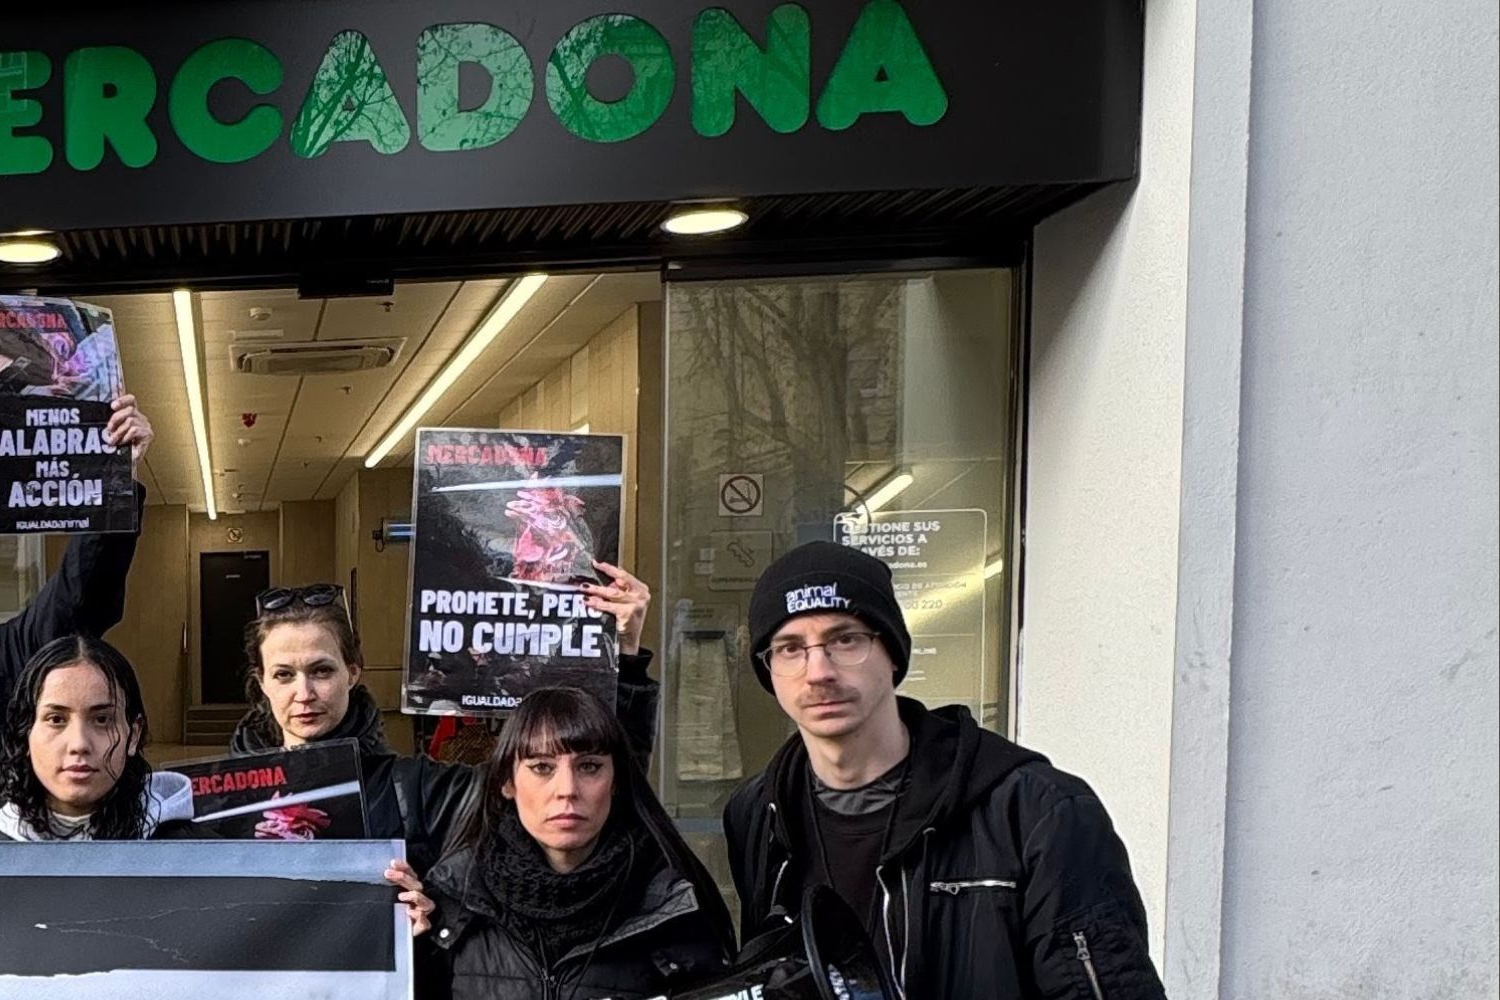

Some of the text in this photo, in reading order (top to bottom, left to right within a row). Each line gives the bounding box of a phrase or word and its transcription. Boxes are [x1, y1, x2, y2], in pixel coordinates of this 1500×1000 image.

[26, 408, 80, 426] MENOS
[424, 444, 547, 467] MERCADONA
[36, 457, 70, 478] MÁS
[8, 473, 102, 508] ACCIÓN
[842, 521, 940, 533] GESTIONE SUS
[842, 533, 928, 546] SERVICIOS A
[897, 545, 920, 556] DE:
[785, 581, 838, 602] animal
[420, 590, 536, 619] PROMETE,
[787, 596, 851, 614] EQUALITY
[418, 620, 603, 657] NO CUMPLE
[191, 766, 287, 796] ERCADONA
